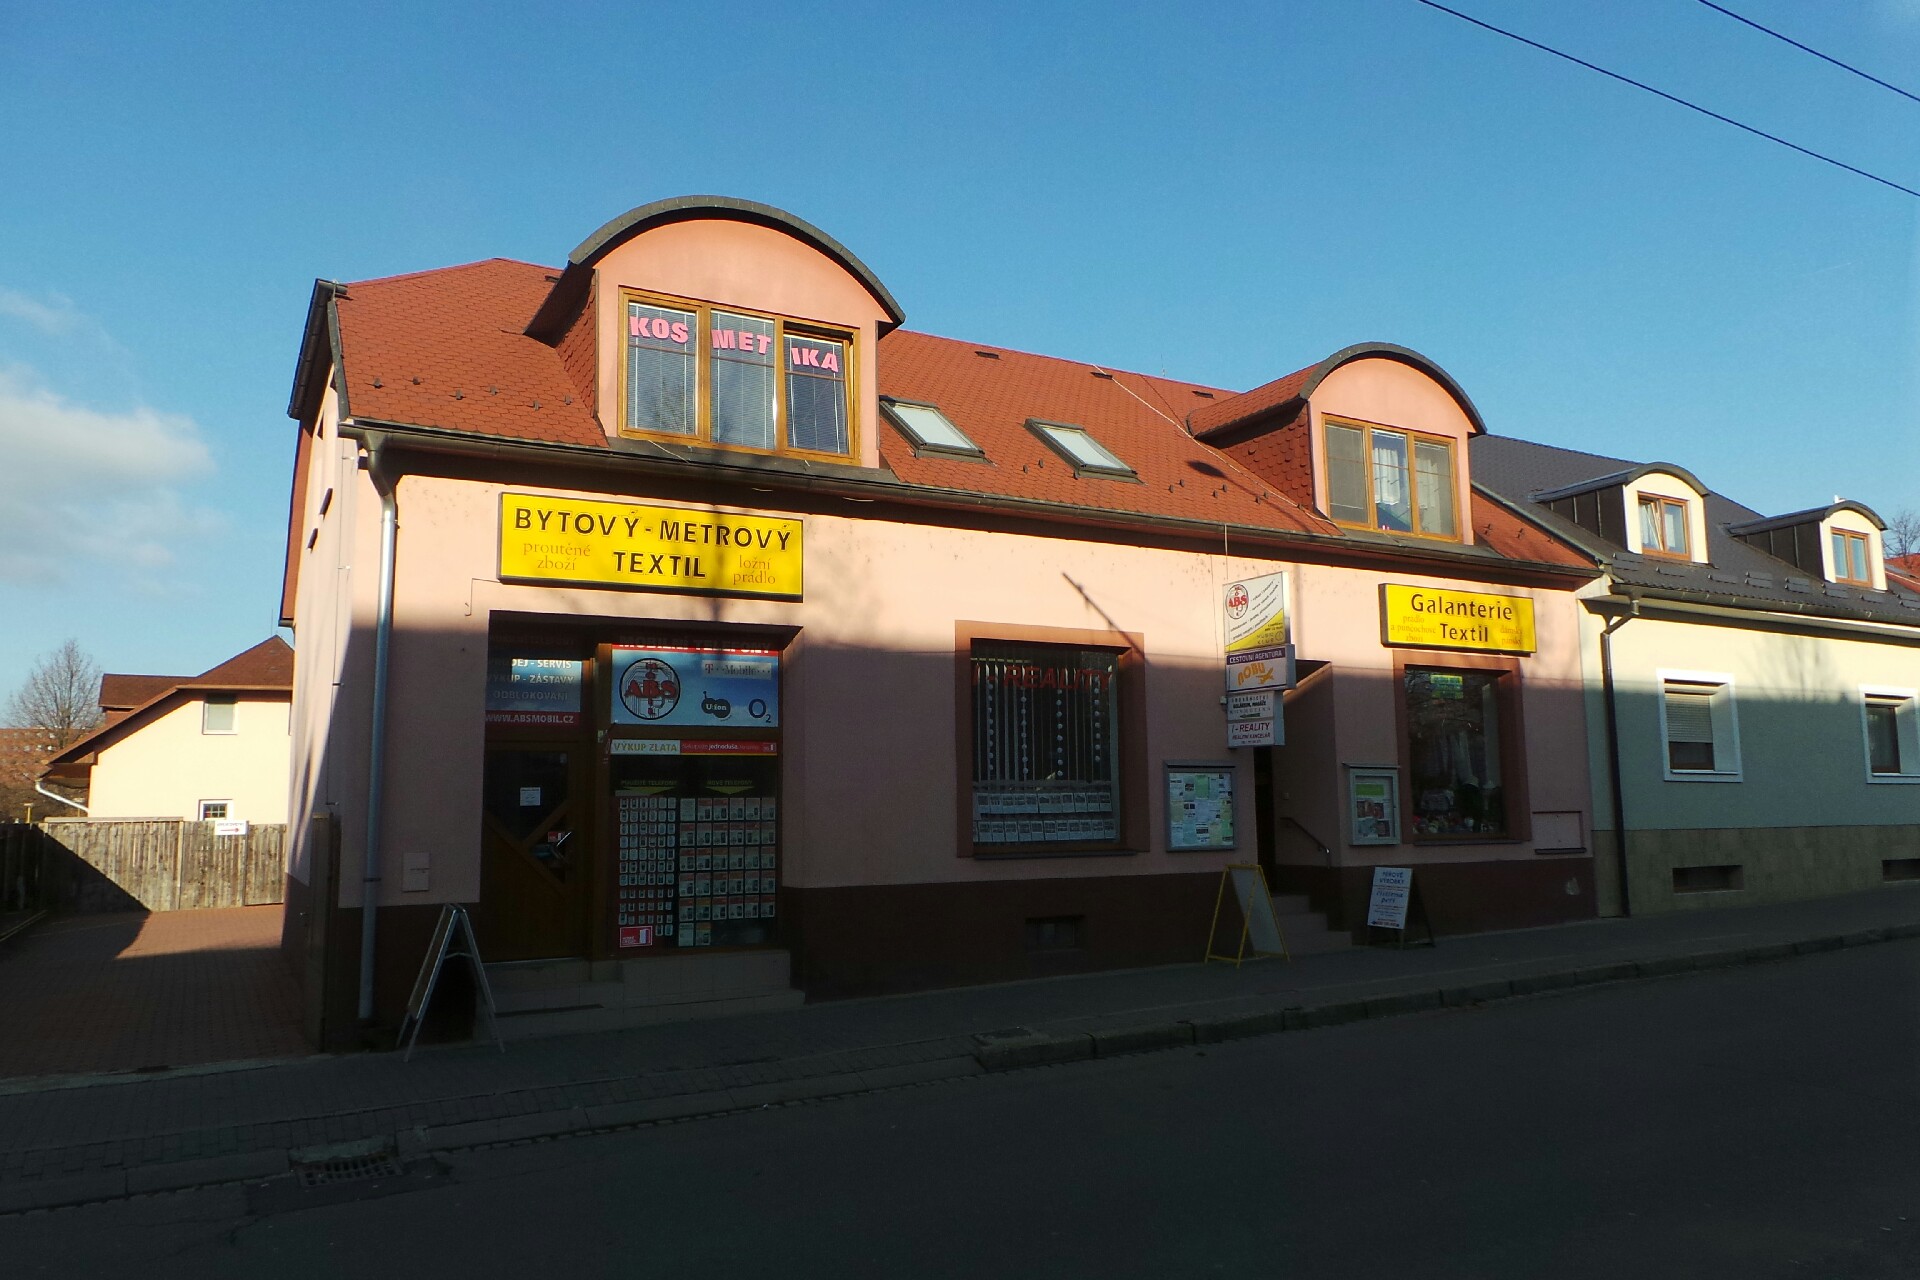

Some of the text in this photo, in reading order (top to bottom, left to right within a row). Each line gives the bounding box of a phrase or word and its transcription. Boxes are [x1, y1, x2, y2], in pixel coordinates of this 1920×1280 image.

[629, 316, 839, 373] KOS MET IKA
[514, 507, 640, 538] BYTOVÝ
[659, 519, 791, 551] METROVÝ
[536, 555, 576, 571] zboží
[612, 551, 706, 578] TEXTIL
[738, 555, 771, 570] ložní
[733, 569, 776, 586] prádlo
[1228, 594, 1248, 608] ABS
[1411, 593, 1513, 621] Galanterie
[1439, 622, 1488, 642] Textil
[537, 659, 571, 669] SERVIS
[1229, 649, 1282, 663] CESTOVNÍ AGENTURA
[529, 673, 574, 684] ZÁSTAVY
[624, 680, 676, 698] ABS
[613, 741, 677, 752] VÝKUP ZLATA
